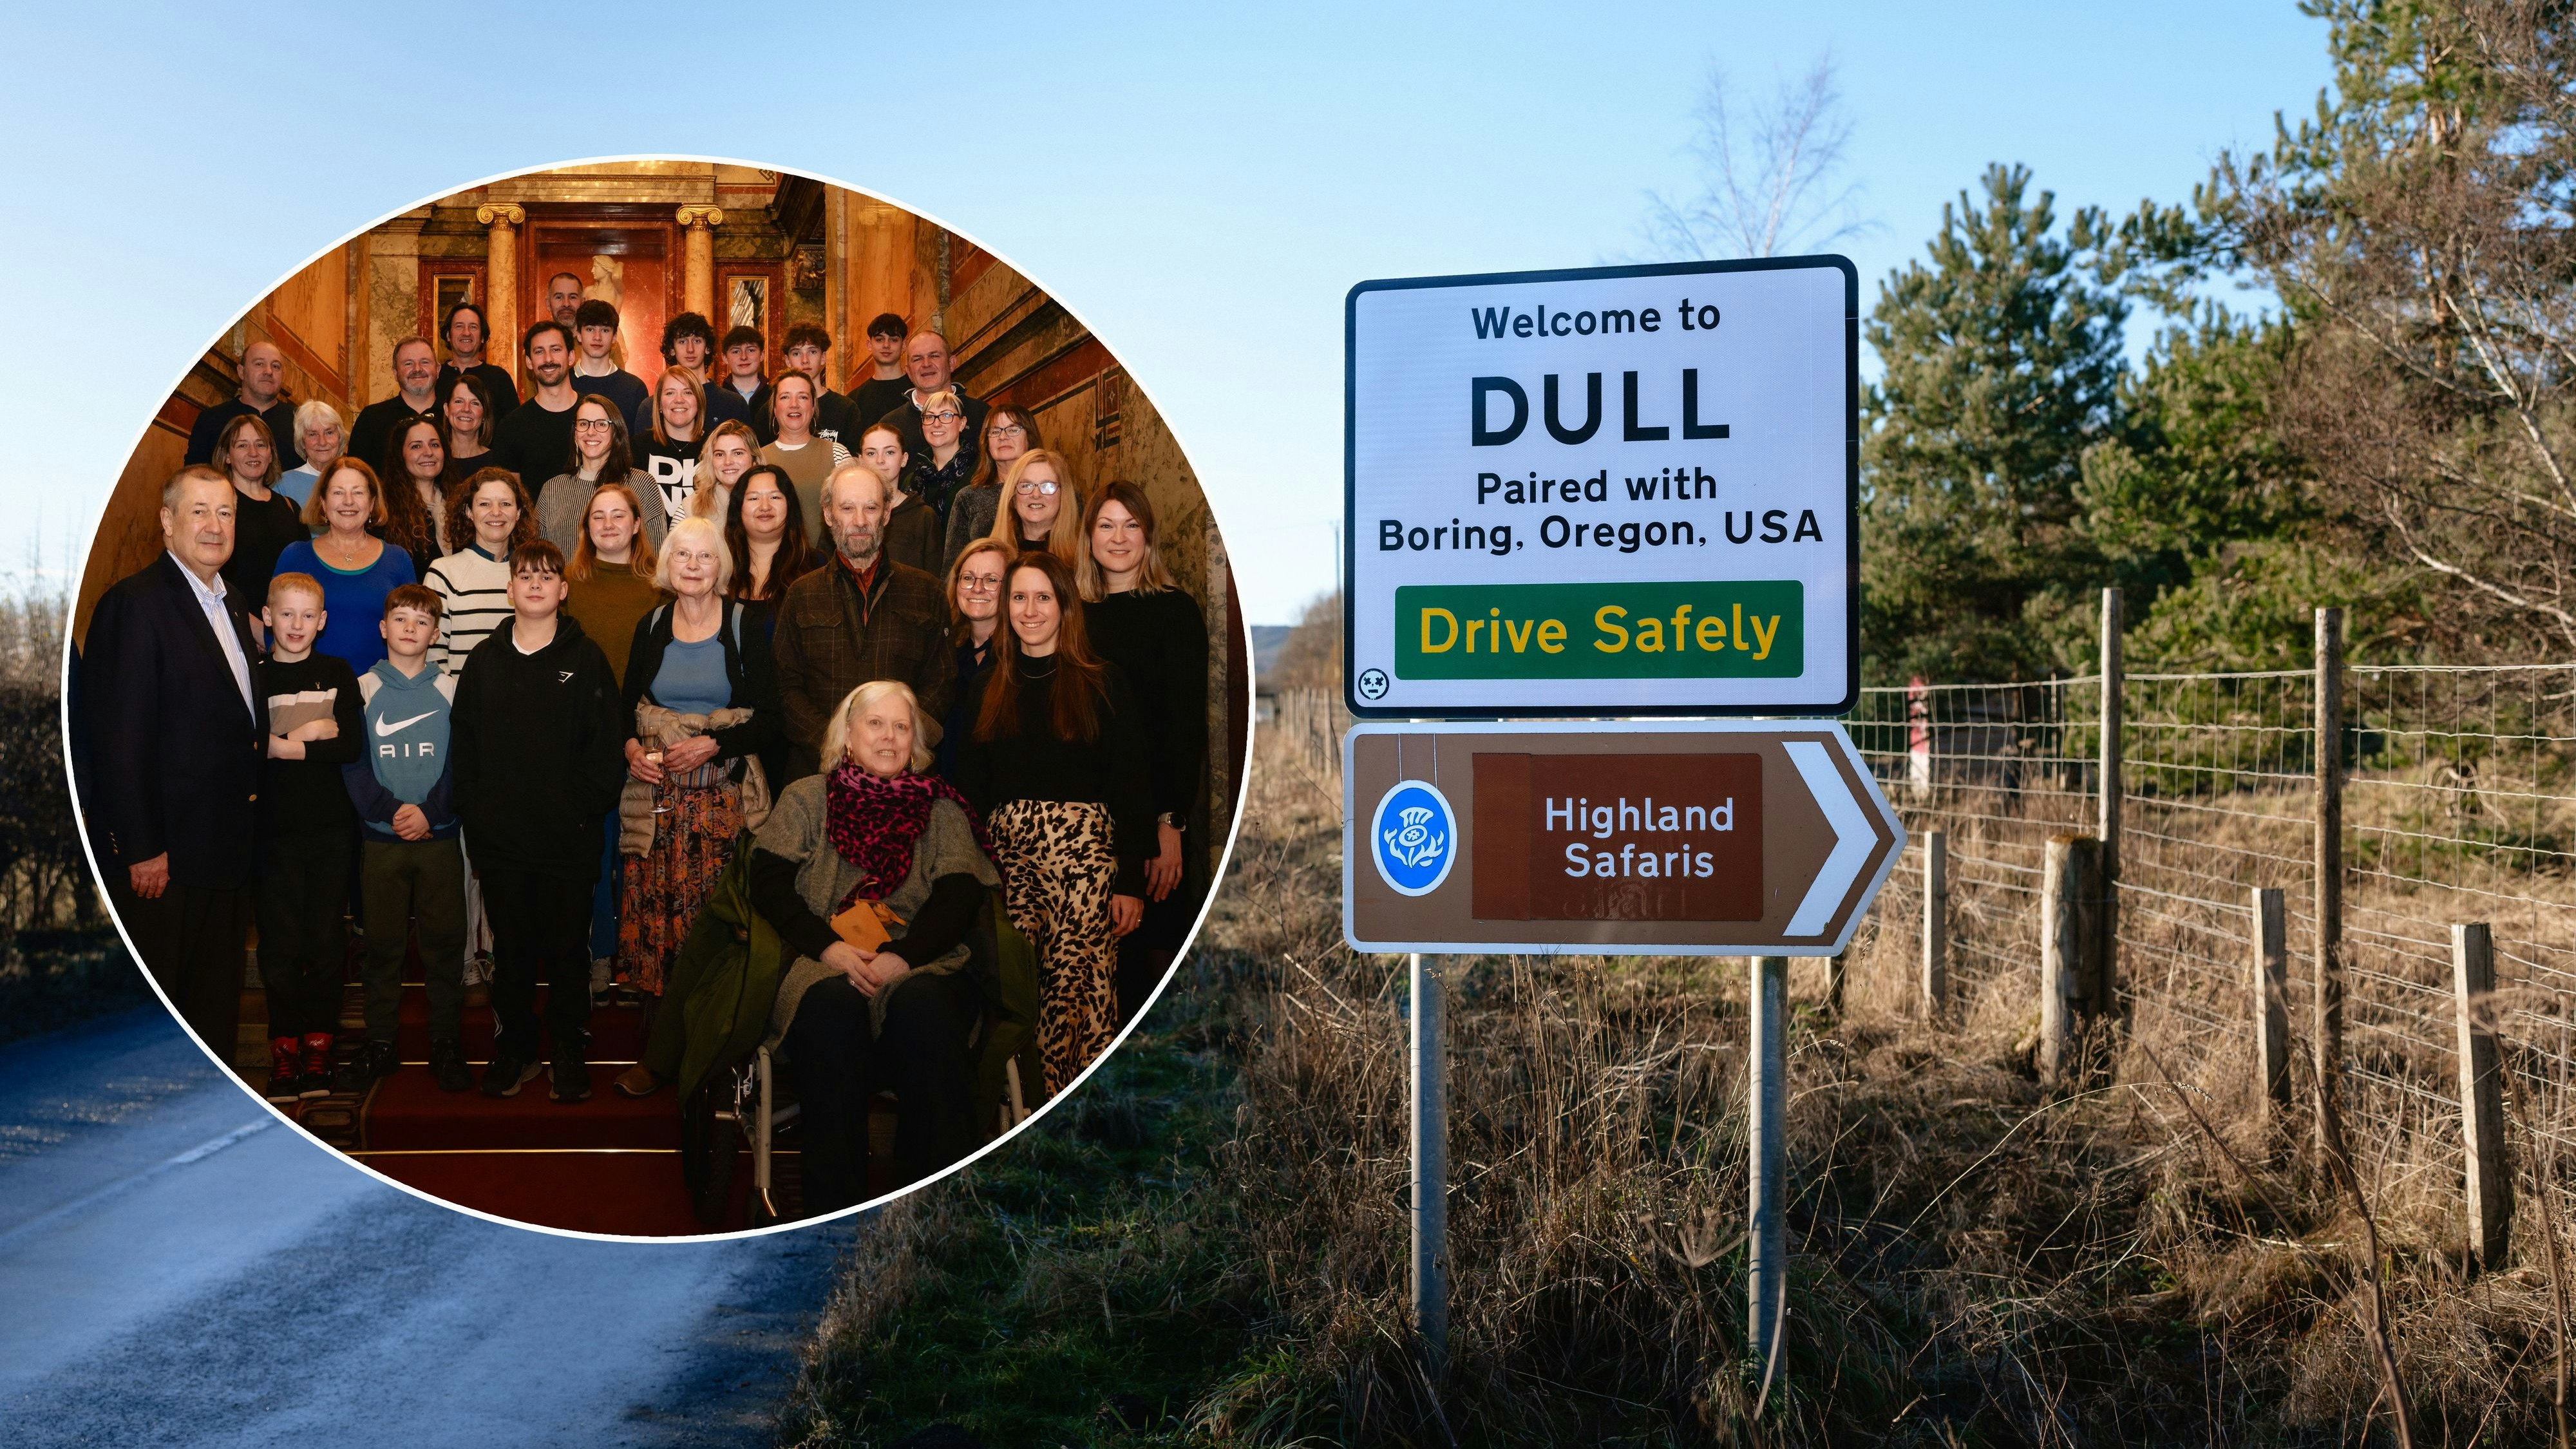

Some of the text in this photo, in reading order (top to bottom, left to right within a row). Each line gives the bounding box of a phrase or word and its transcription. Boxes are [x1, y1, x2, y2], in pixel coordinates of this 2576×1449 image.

[1471, 298, 1720, 339] Welcome to
[1472, 368, 1730, 447] DULL
[1477, 466, 1716, 505] Paired with
[1379, 509, 1823, 556] Boring, Oregon, USA
[1421, 603, 1780, 660] Drive Safely
[379, 742, 435, 758] AIR
[1546, 797, 1733, 838] Highland
[1564, 842, 1714, 878] Safaris
